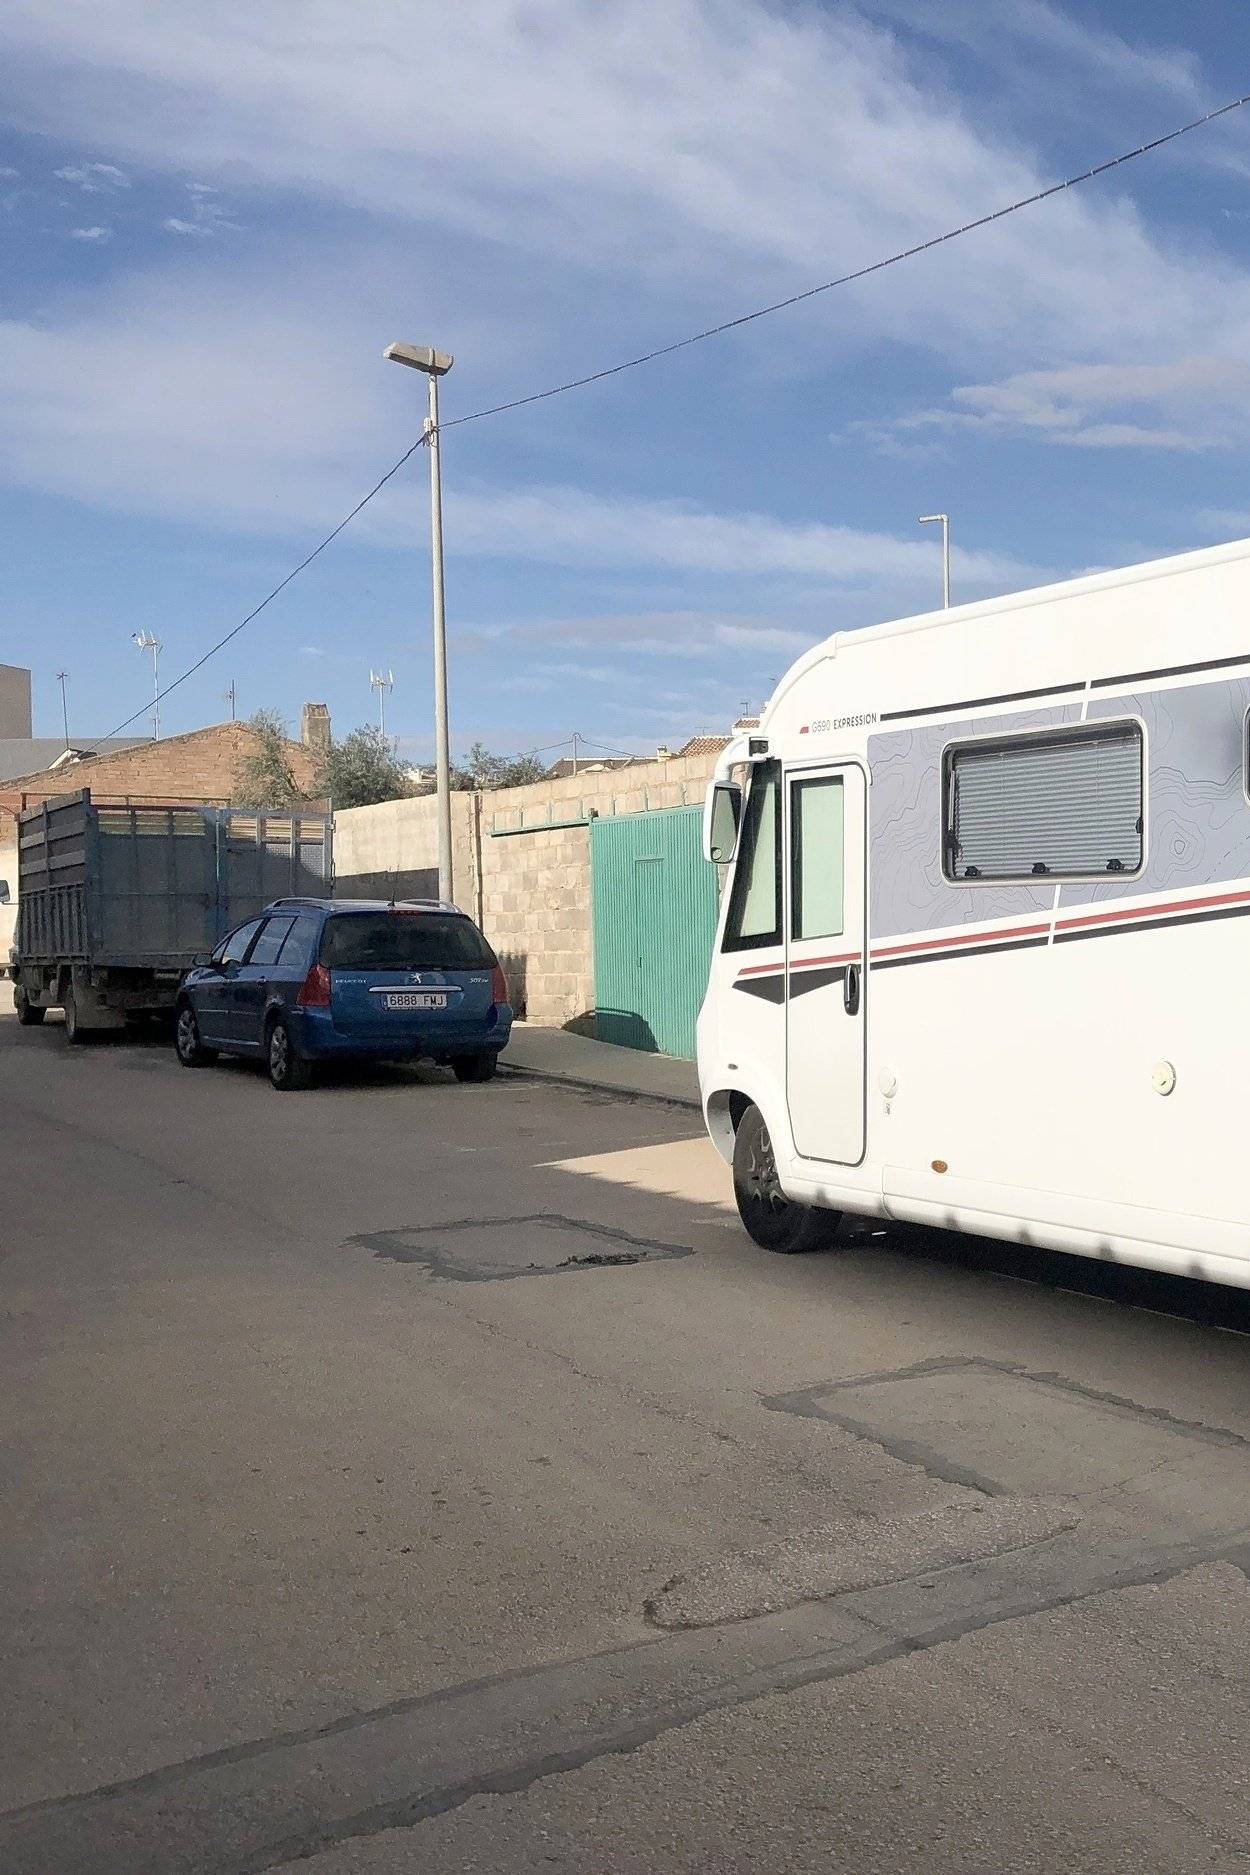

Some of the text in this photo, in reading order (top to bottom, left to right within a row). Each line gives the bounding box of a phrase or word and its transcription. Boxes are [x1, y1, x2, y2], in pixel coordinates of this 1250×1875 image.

[833, 713, 877, 730] EXPRESSION
[389, 995, 417, 1007] 6888
[423, 995, 444, 1007] FMJ
